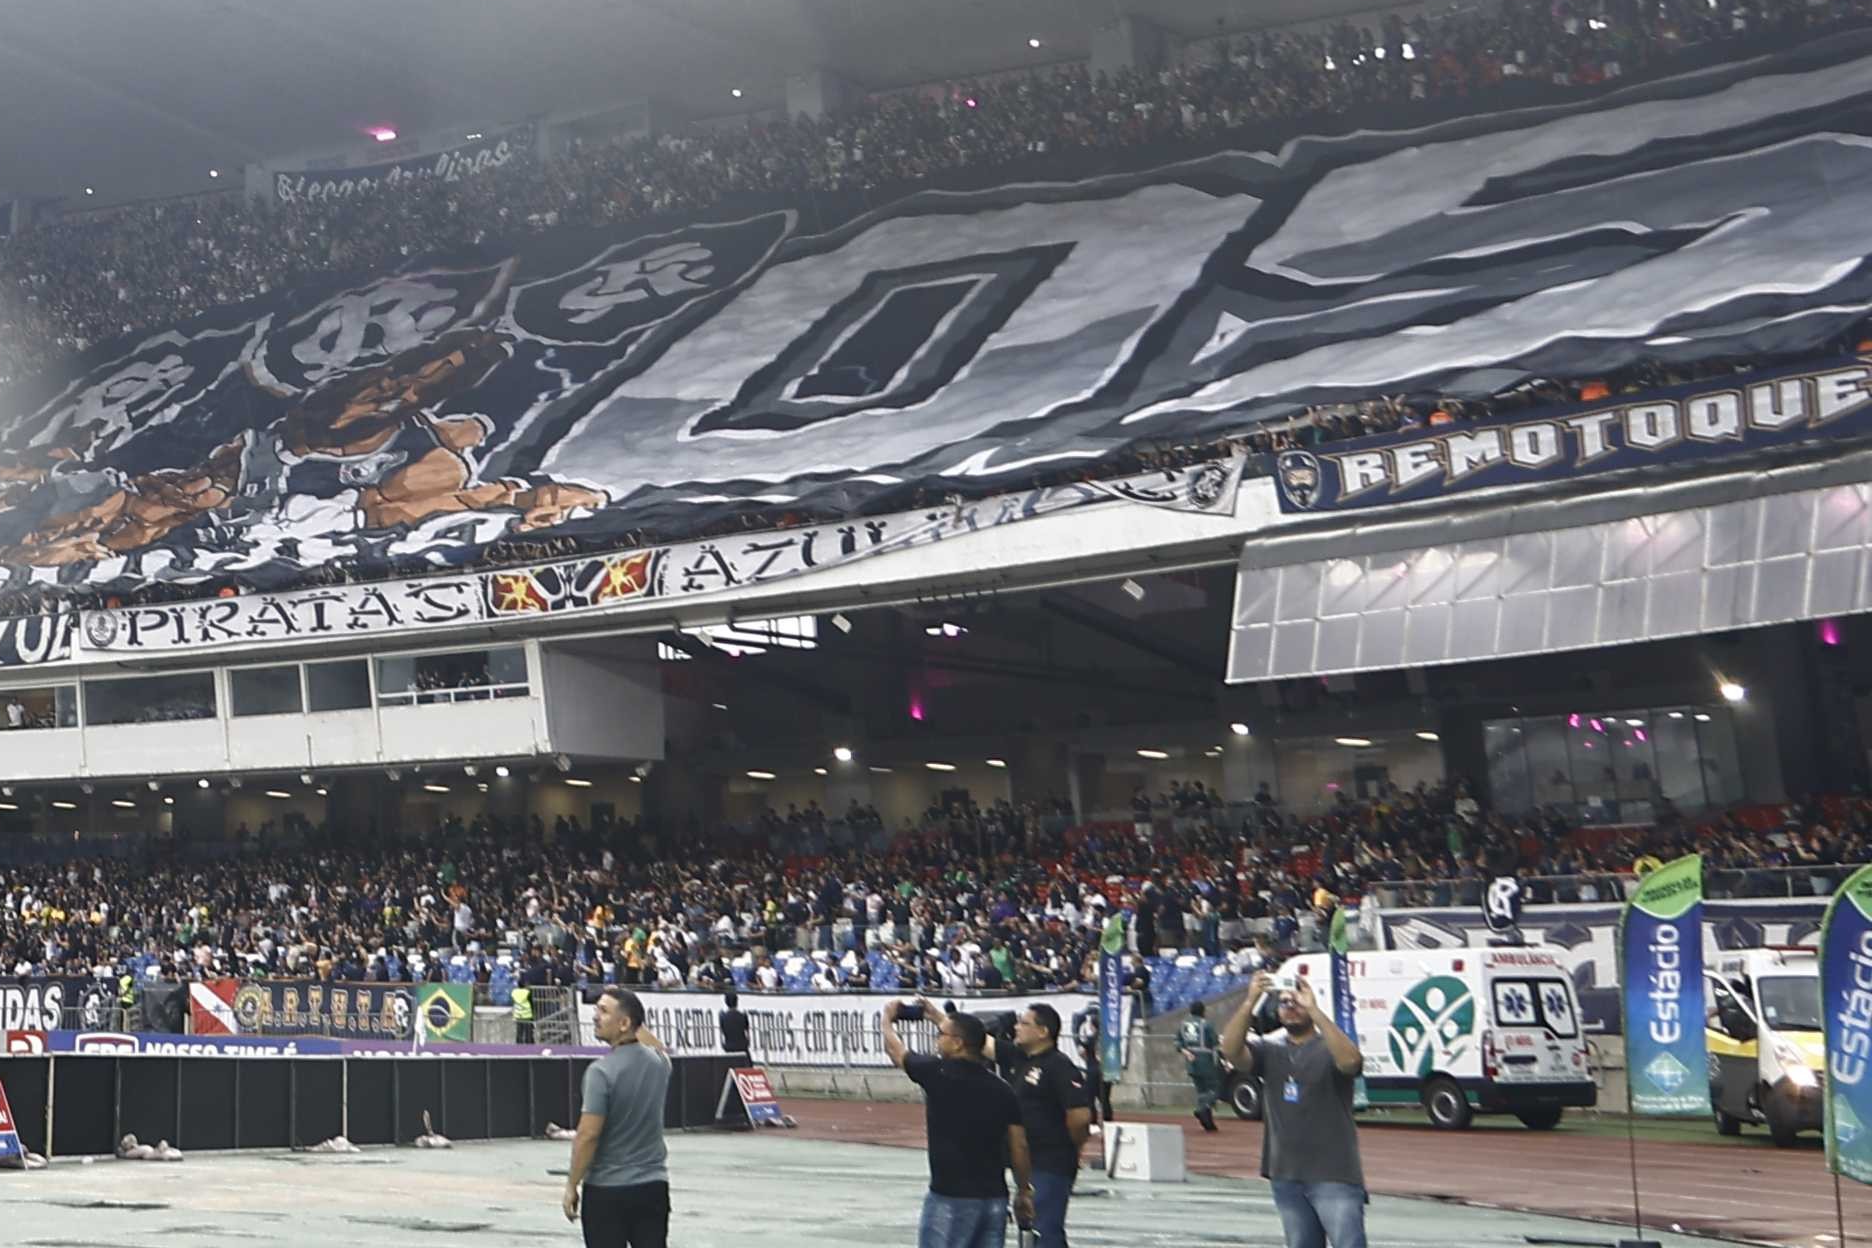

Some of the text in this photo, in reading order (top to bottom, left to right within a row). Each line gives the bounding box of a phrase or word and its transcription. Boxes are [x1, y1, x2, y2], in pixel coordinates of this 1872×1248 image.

[1340, 367, 1872, 497] REMOTOQUE
[123, 581, 472, 647] PIRATAS
[1648, 923, 1680, 1045] Estácio
